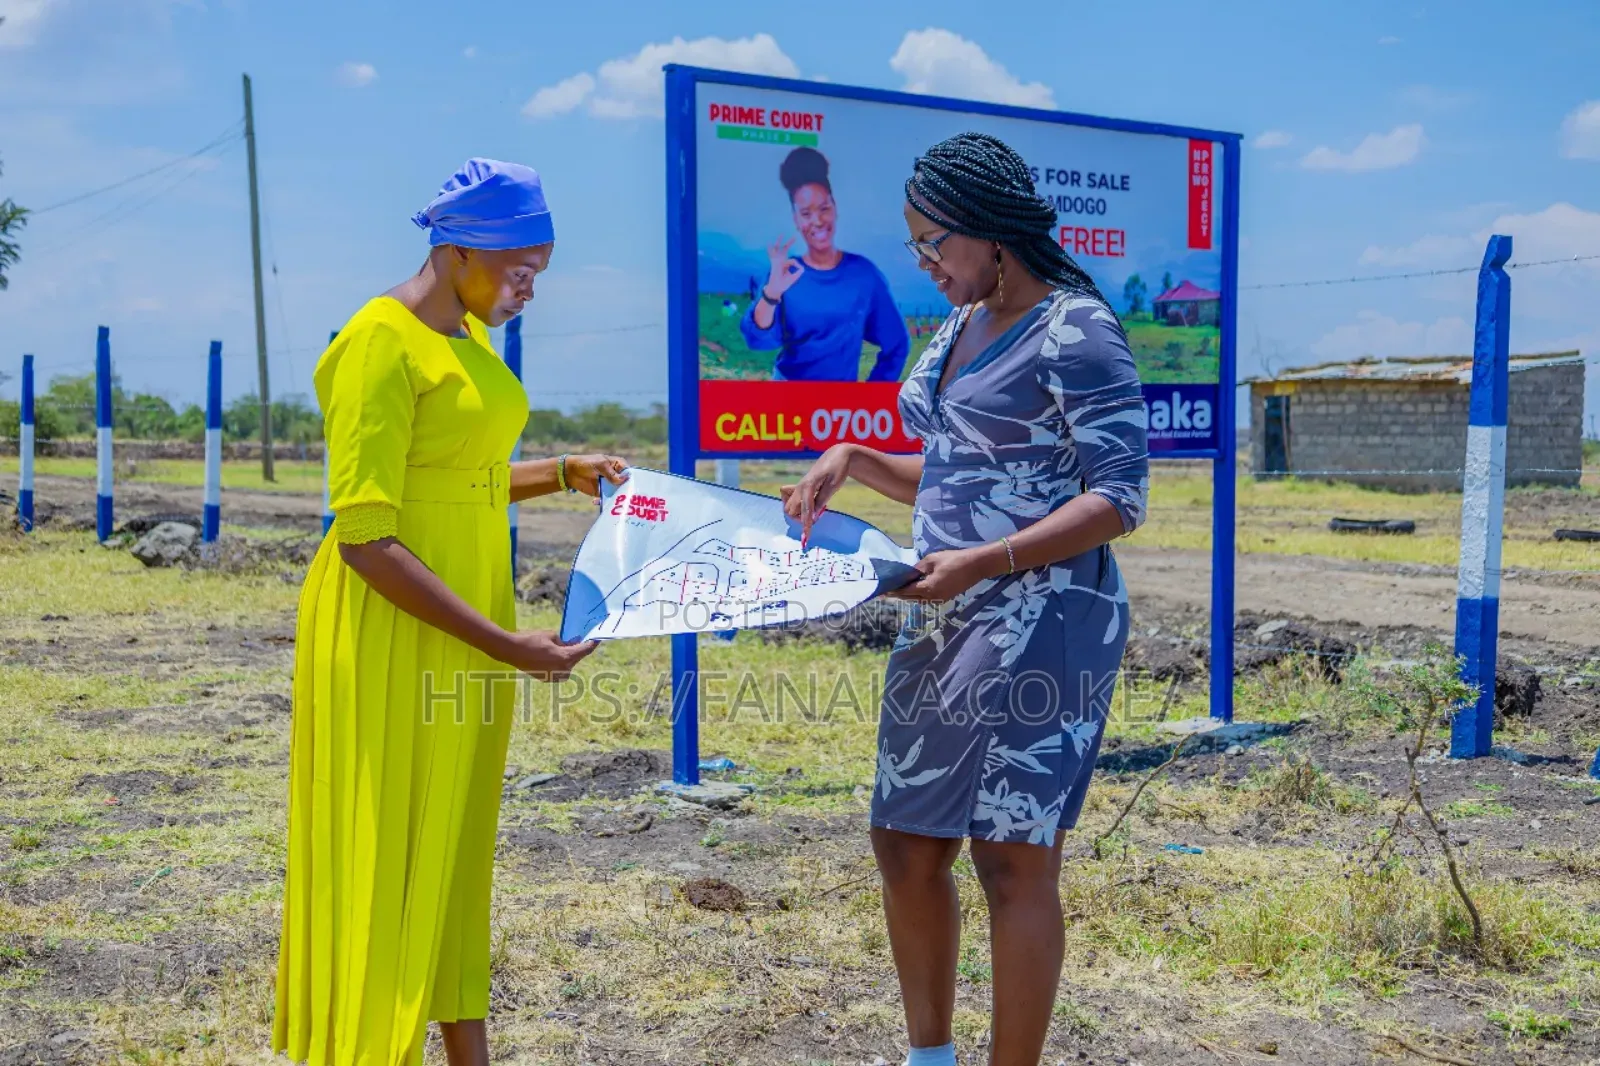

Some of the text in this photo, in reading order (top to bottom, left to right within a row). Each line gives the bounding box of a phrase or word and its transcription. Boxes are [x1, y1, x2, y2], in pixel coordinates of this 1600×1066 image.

[709, 102, 825, 132] PRIME COURT
[1045, 167, 1082, 188] FOR
[1086, 171, 1131, 192] SALE
[1060, 225, 1126, 258] FREE!
[715, 412, 803, 447] CALL;
[810, 408, 893, 441] 0700
